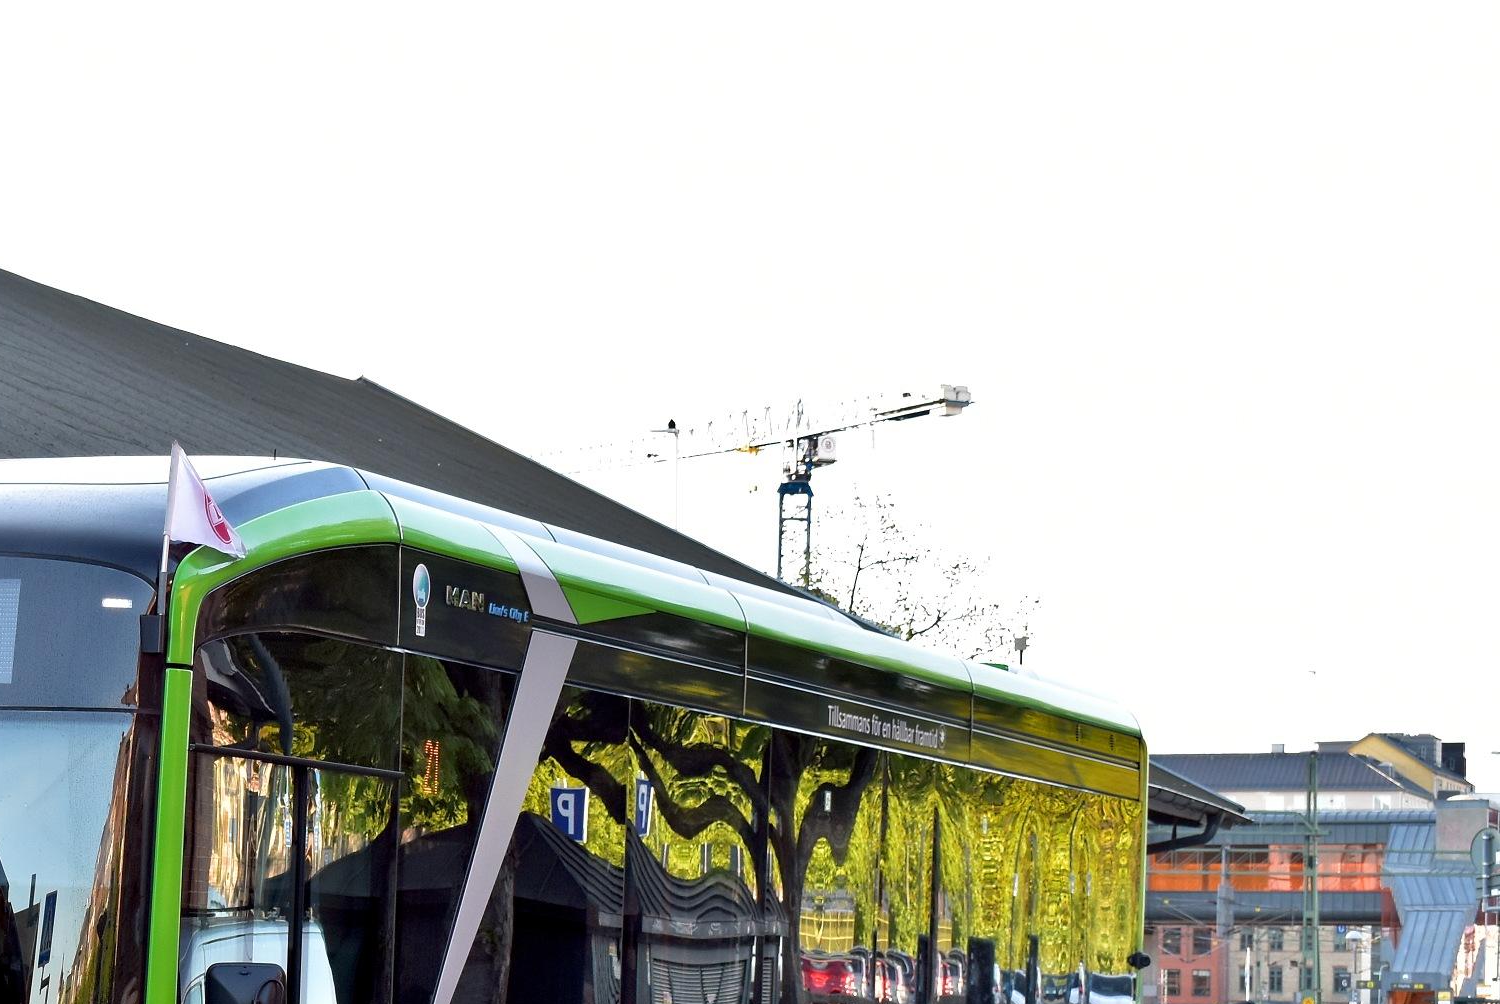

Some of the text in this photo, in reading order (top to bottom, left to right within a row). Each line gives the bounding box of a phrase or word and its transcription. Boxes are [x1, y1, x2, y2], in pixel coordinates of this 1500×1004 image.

[445, 585, 485, 613] MAN
[524, 611, 530, 622] E
[827, 704, 871, 734] Tillsammans
[871, 713, 881, 736] för
[882, 721, 891, 738] en
[423, 740, 439, 794] 21
